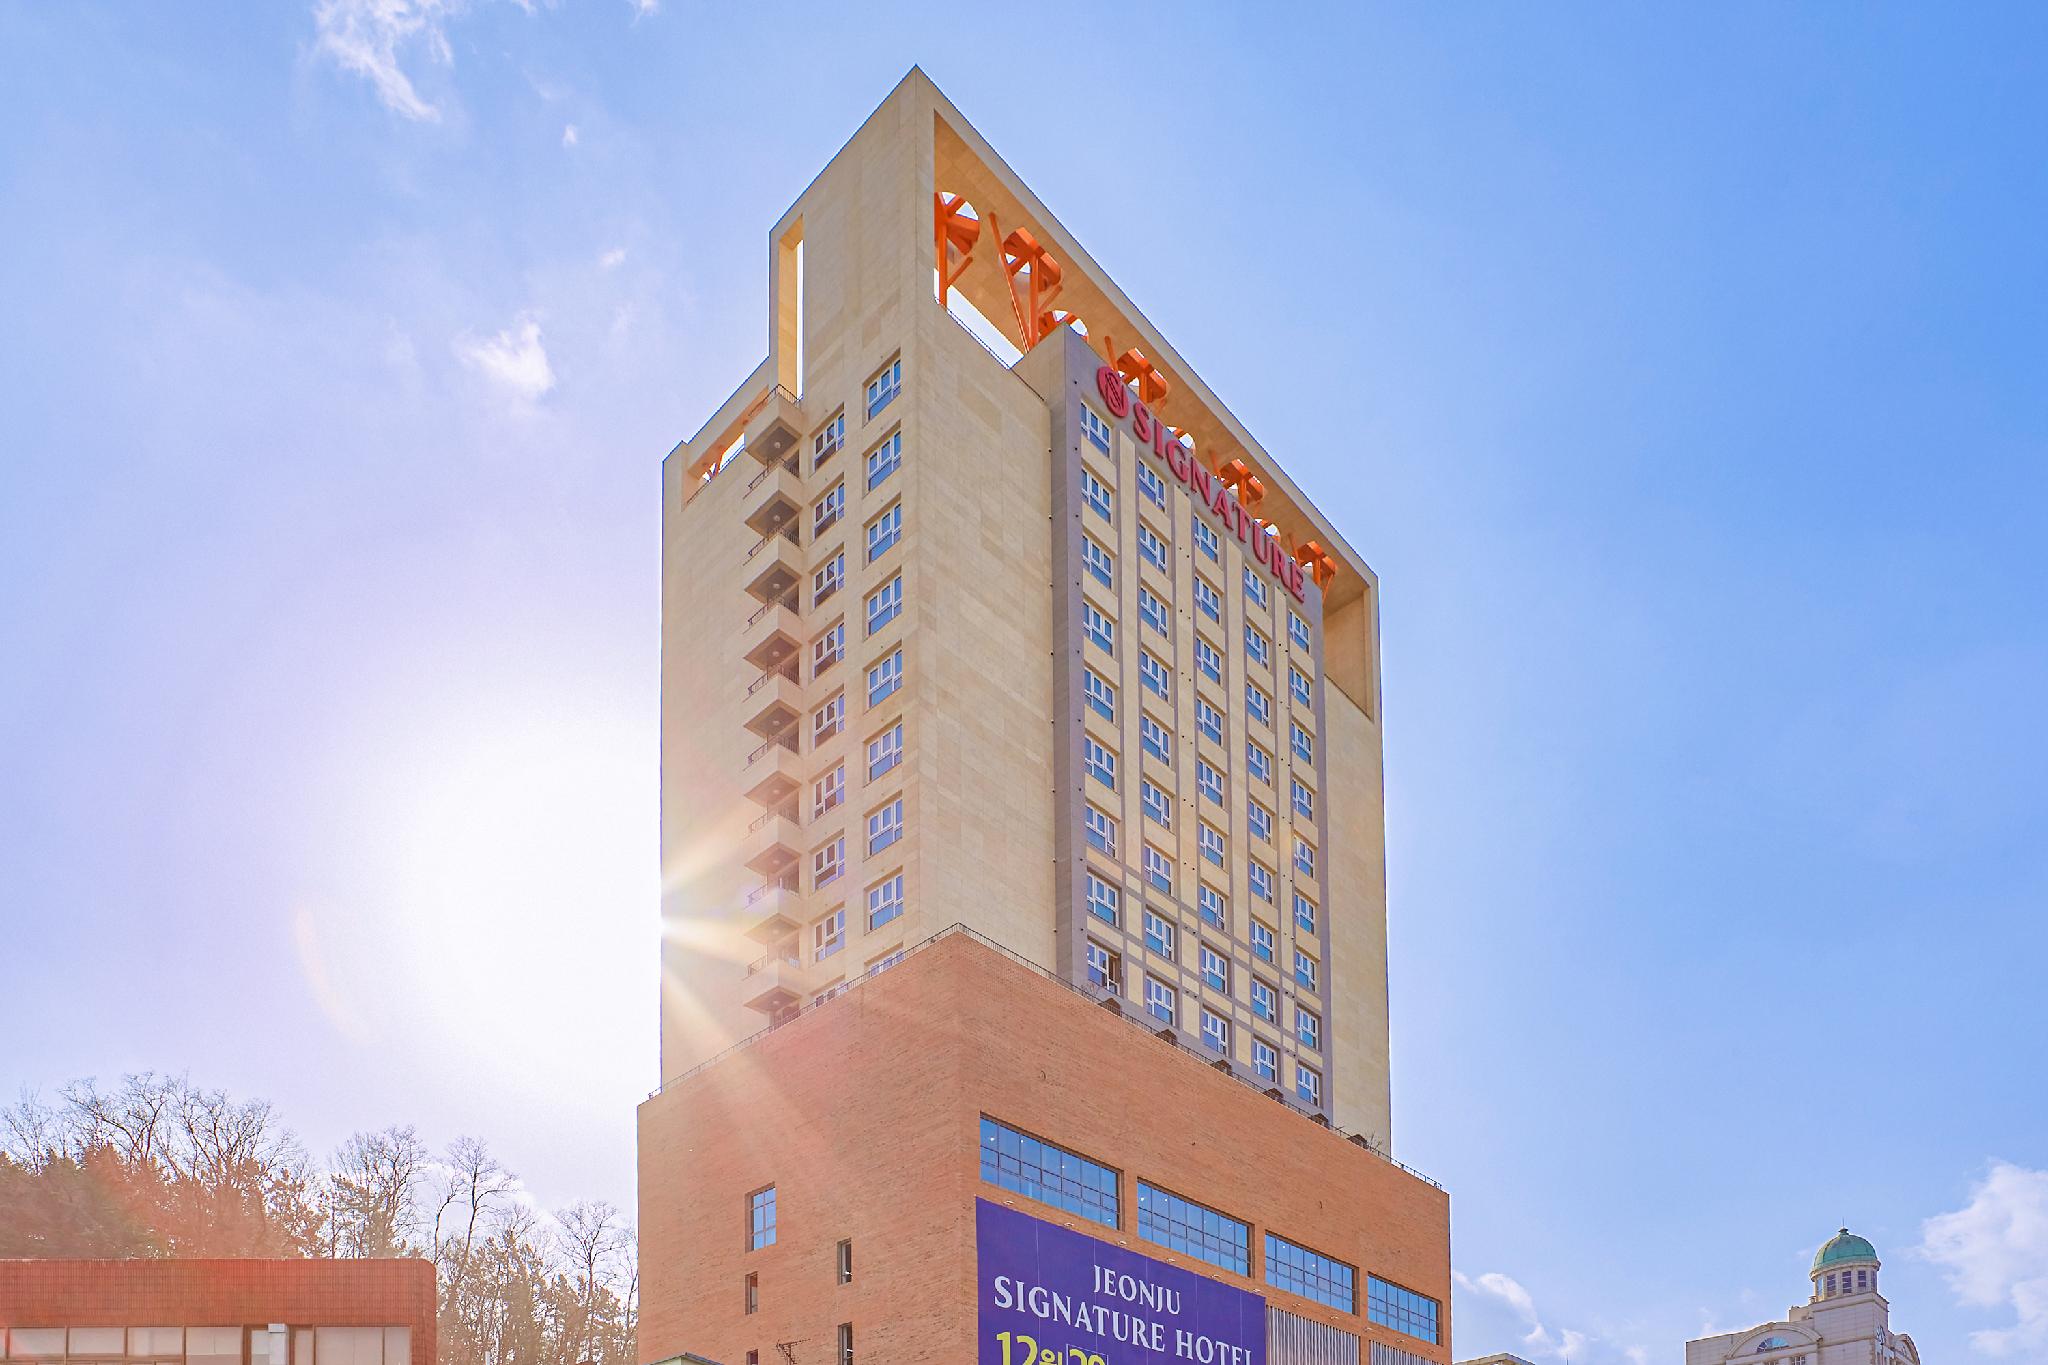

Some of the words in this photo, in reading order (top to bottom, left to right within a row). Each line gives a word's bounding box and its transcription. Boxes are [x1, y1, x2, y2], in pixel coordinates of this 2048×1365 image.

[1133, 402, 1305, 604] SIGNATURE
[993, 1275, 1165, 1353] SIGNATURE
[1093, 1264, 1181, 1315] JEONJU
